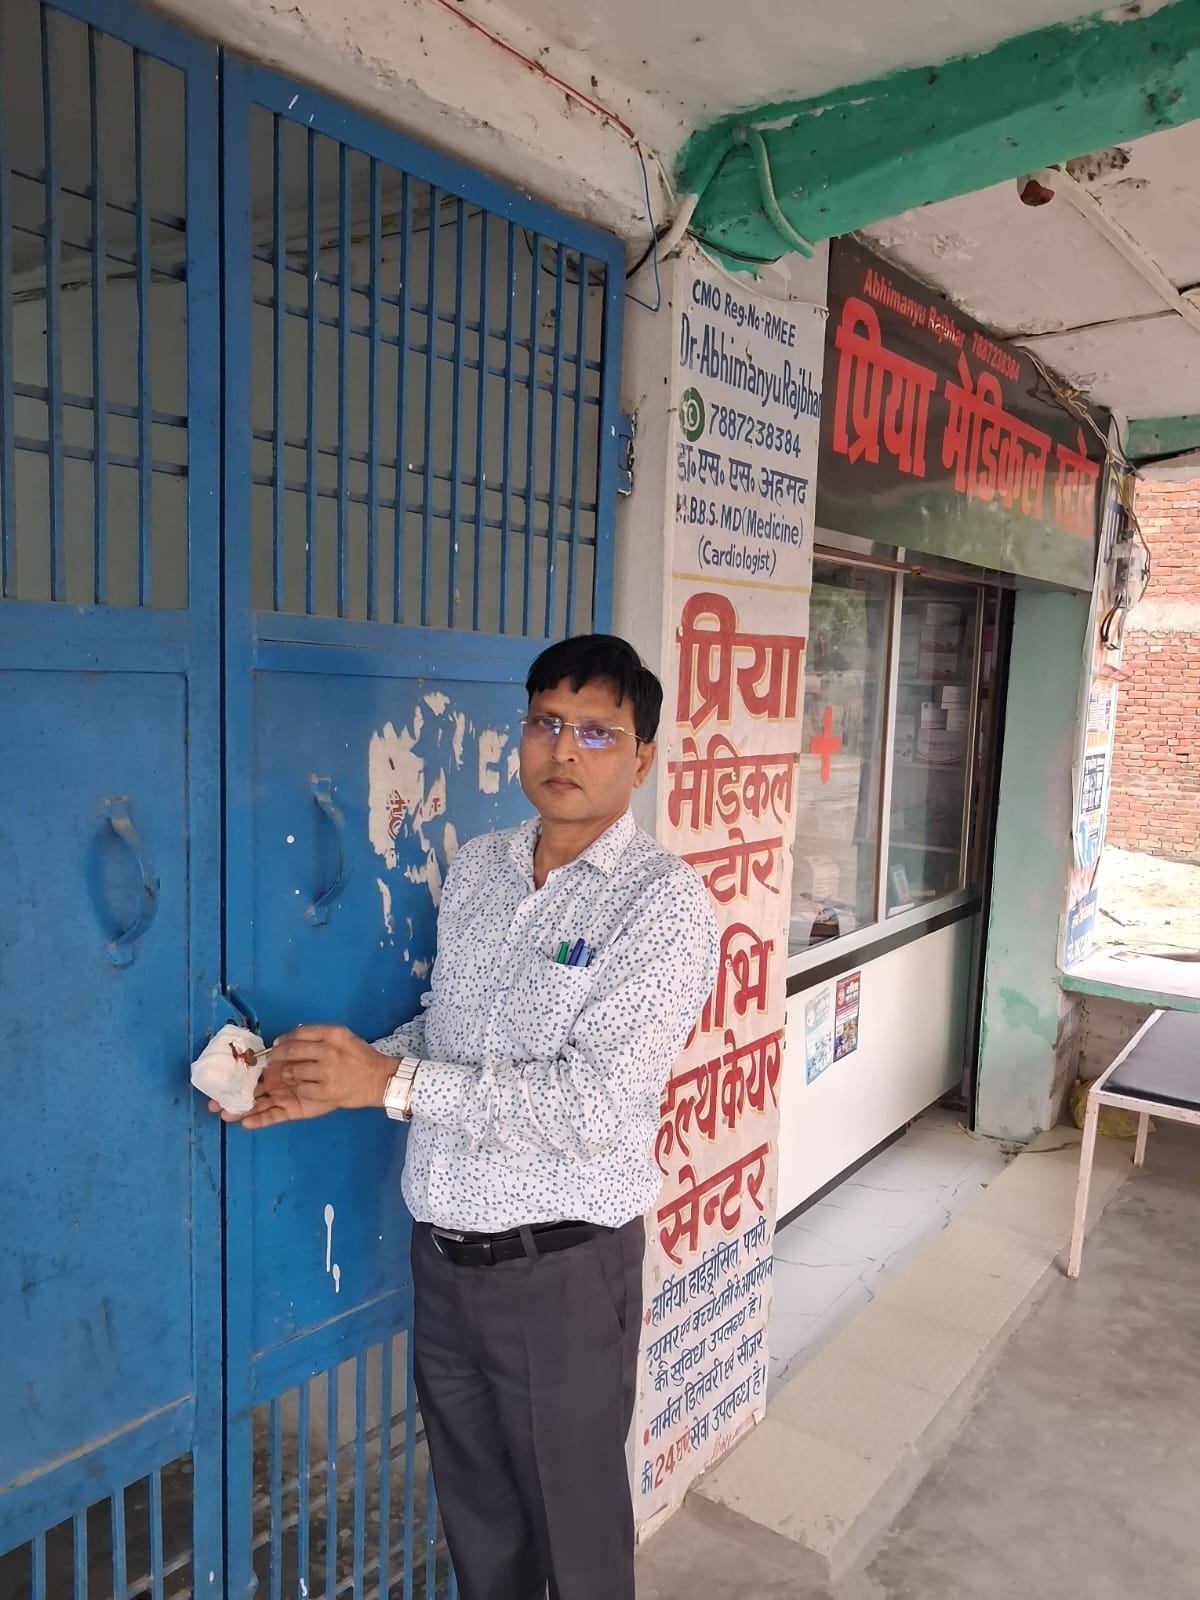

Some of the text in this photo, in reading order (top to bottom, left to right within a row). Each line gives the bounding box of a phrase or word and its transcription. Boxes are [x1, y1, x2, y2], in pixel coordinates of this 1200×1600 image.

[692, 279, 721, 311] CMO
[863, 268, 927, 327] Abhimanyu
[709, 403, 802, 458] 7887238384
[833, 296, 937, 478] प्रिया
[942, 351, 1052, 521] मेडिकल
[758, 467, 808, 508] अहमद
[698, 534, 777, 577] (Cardiologist)
[676, 592, 806, 730] प्रिया
[668, 734, 800, 831] मेडिकल
[657, 1142, 769, 1266] सेन्टर
[670, 1338, 707, 1387] सुविधा
[707, 1306, 748, 1353] उपलब्ध
[736, 1328, 763, 1366] सीजर
[654, 1443, 676, 1490] 24
[691, 1412, 711, 1451] सेवा
[711, 1375, 752, 1432] उपलब्ध
